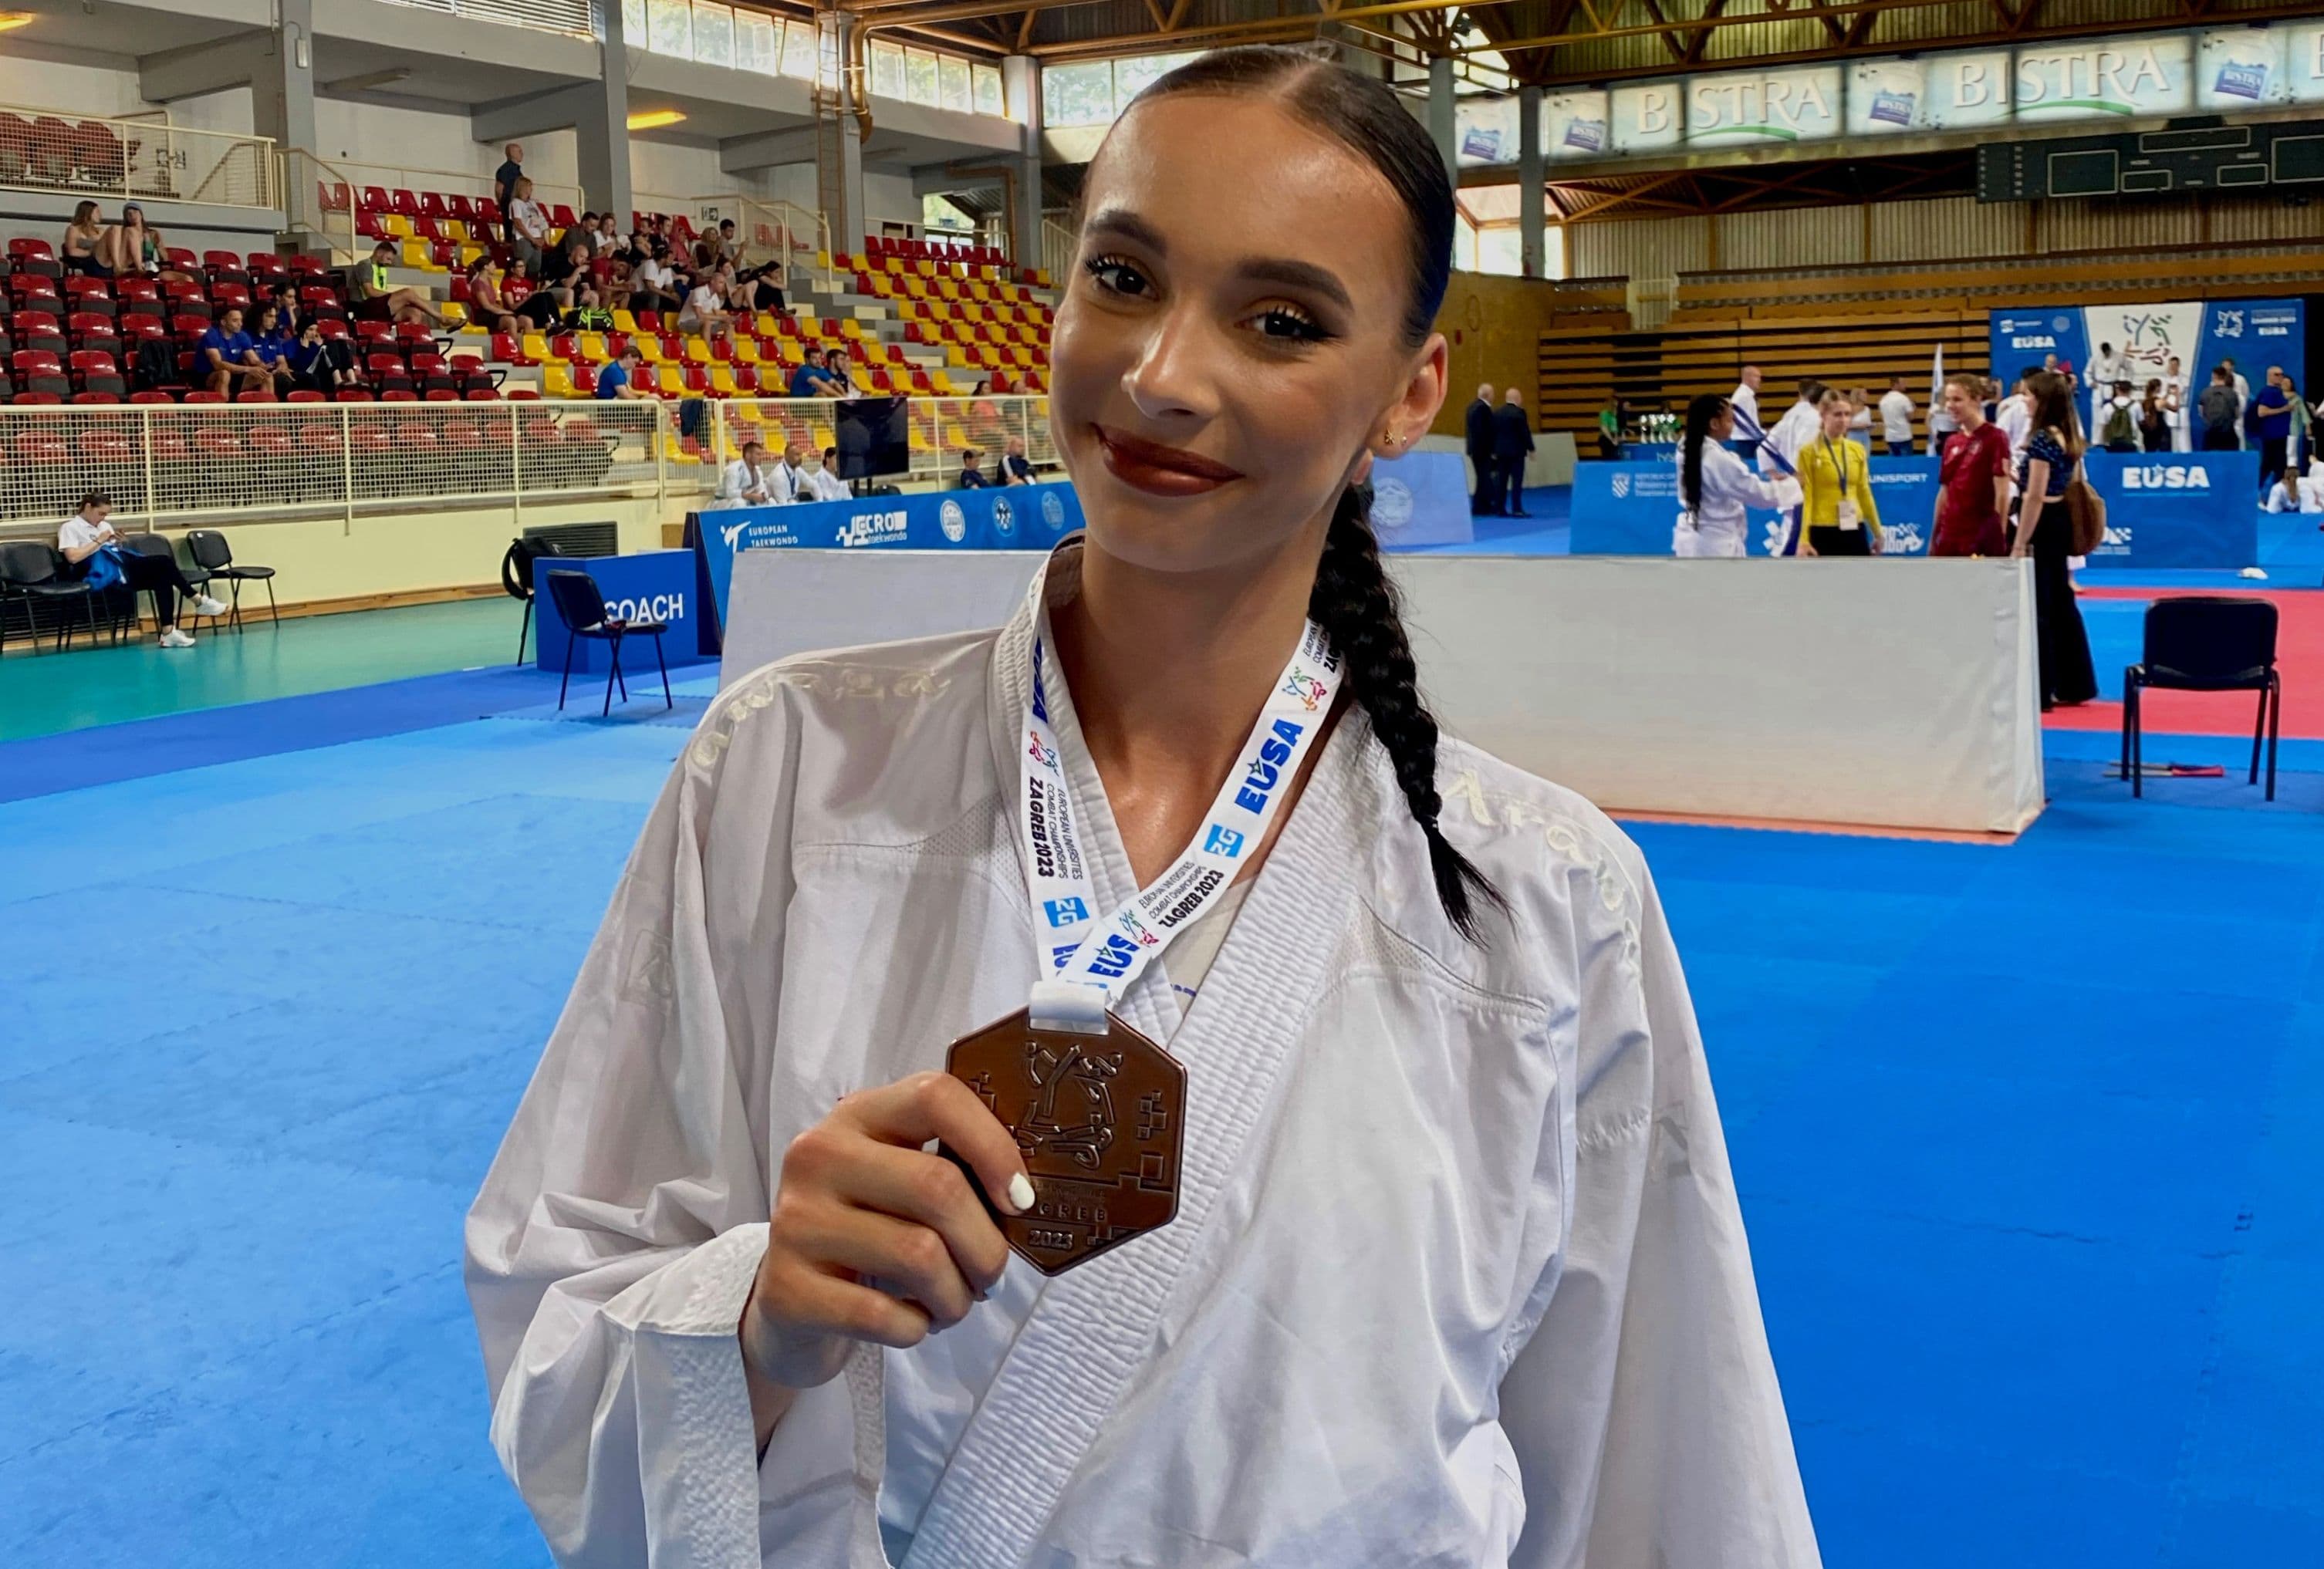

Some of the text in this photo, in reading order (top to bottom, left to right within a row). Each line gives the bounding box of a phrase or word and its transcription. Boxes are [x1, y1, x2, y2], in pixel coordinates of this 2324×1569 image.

[1953, 46, 2170, 109] BISTRA
[2123, 465, 2211, 488] EUSA
[748, 525, 788, 537] EUROPEAN
[751, 535, 799, 548] TAEKWONDO
[1235, 719, 1304, 815] EUSA
[1030, 776, 1055, 877] ZAGREB 2023
[1158, 869, 1224, 928] ZAGREB 2023
[1086, 934, 1140, 977] EUS
[1039, 1203, 1108, 1223] GREB
[1029, 1229, 1073, 1250] 2023
